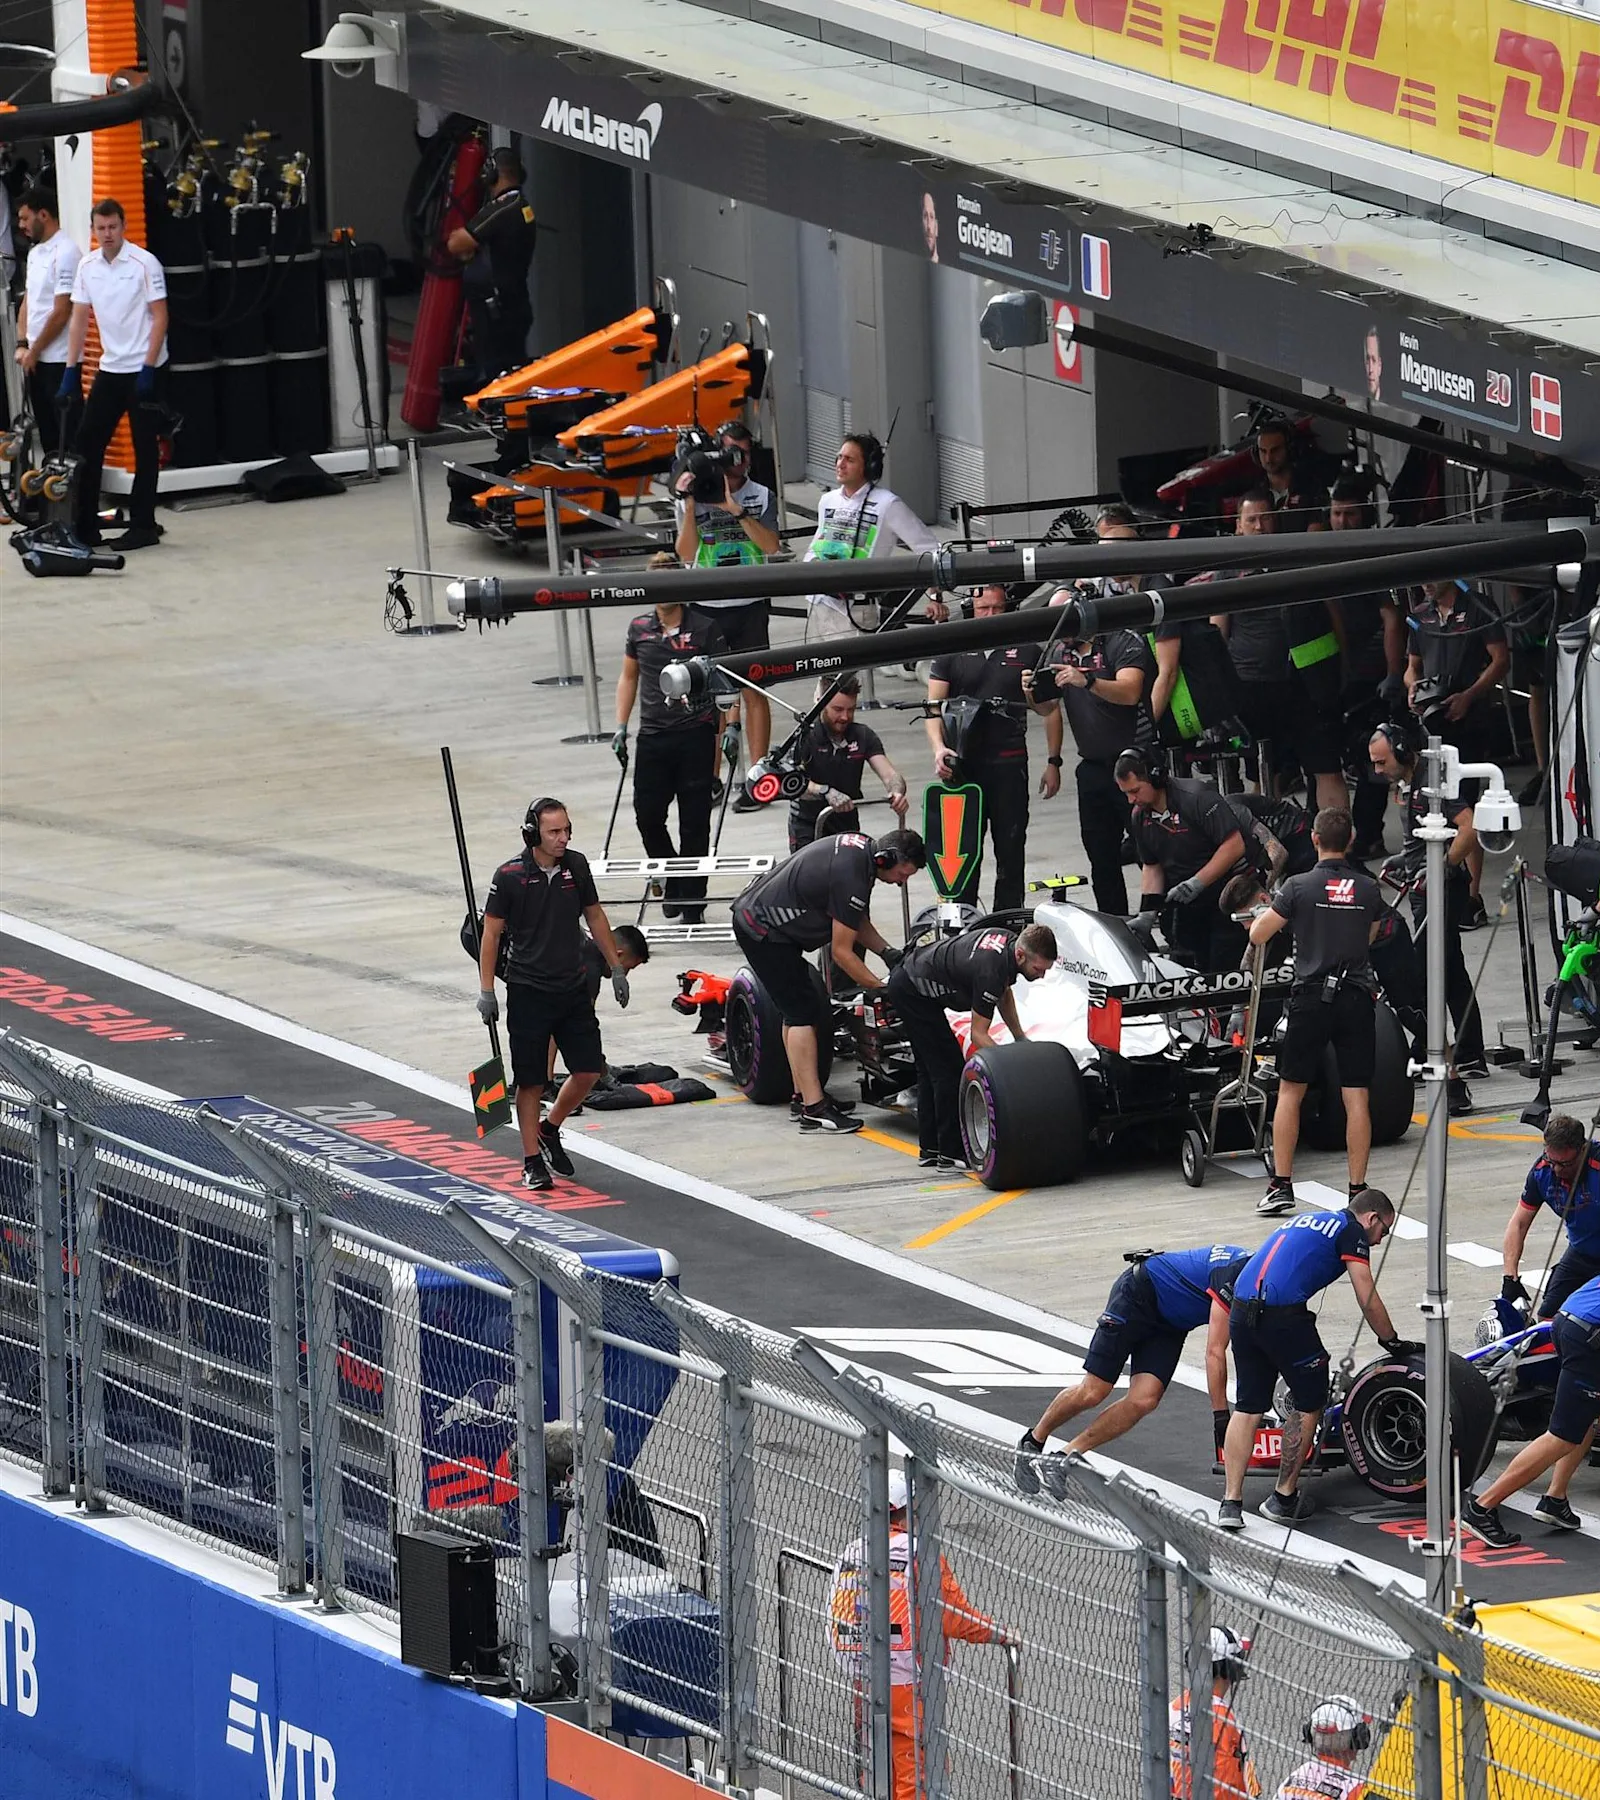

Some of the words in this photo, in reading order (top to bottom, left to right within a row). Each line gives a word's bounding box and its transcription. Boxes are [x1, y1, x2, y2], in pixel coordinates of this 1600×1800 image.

[540, 96, 650, 161] McLaren
[956, 193, 981, 215] Romain
[957, 215, 1013, 258] Grosjean
[1399, 331, 1420, 351] Kevin
[1400, 352, 1475, 403] Magnussen
[1486, 369, 1512, 407] 20
[591, 587, 606, 600] F1
[609, 586, 645, 598] Team
[764, 662, 794, 676] Haas
[796, 659, 809, 671] F1
[811, 655, 842, 669] Team
[1061, 958, 1108, 981] HaasCNC.com
[1121, 965, 1295, 1001] JACK&JONES
[260, 1712, 337, 1800] VTB
